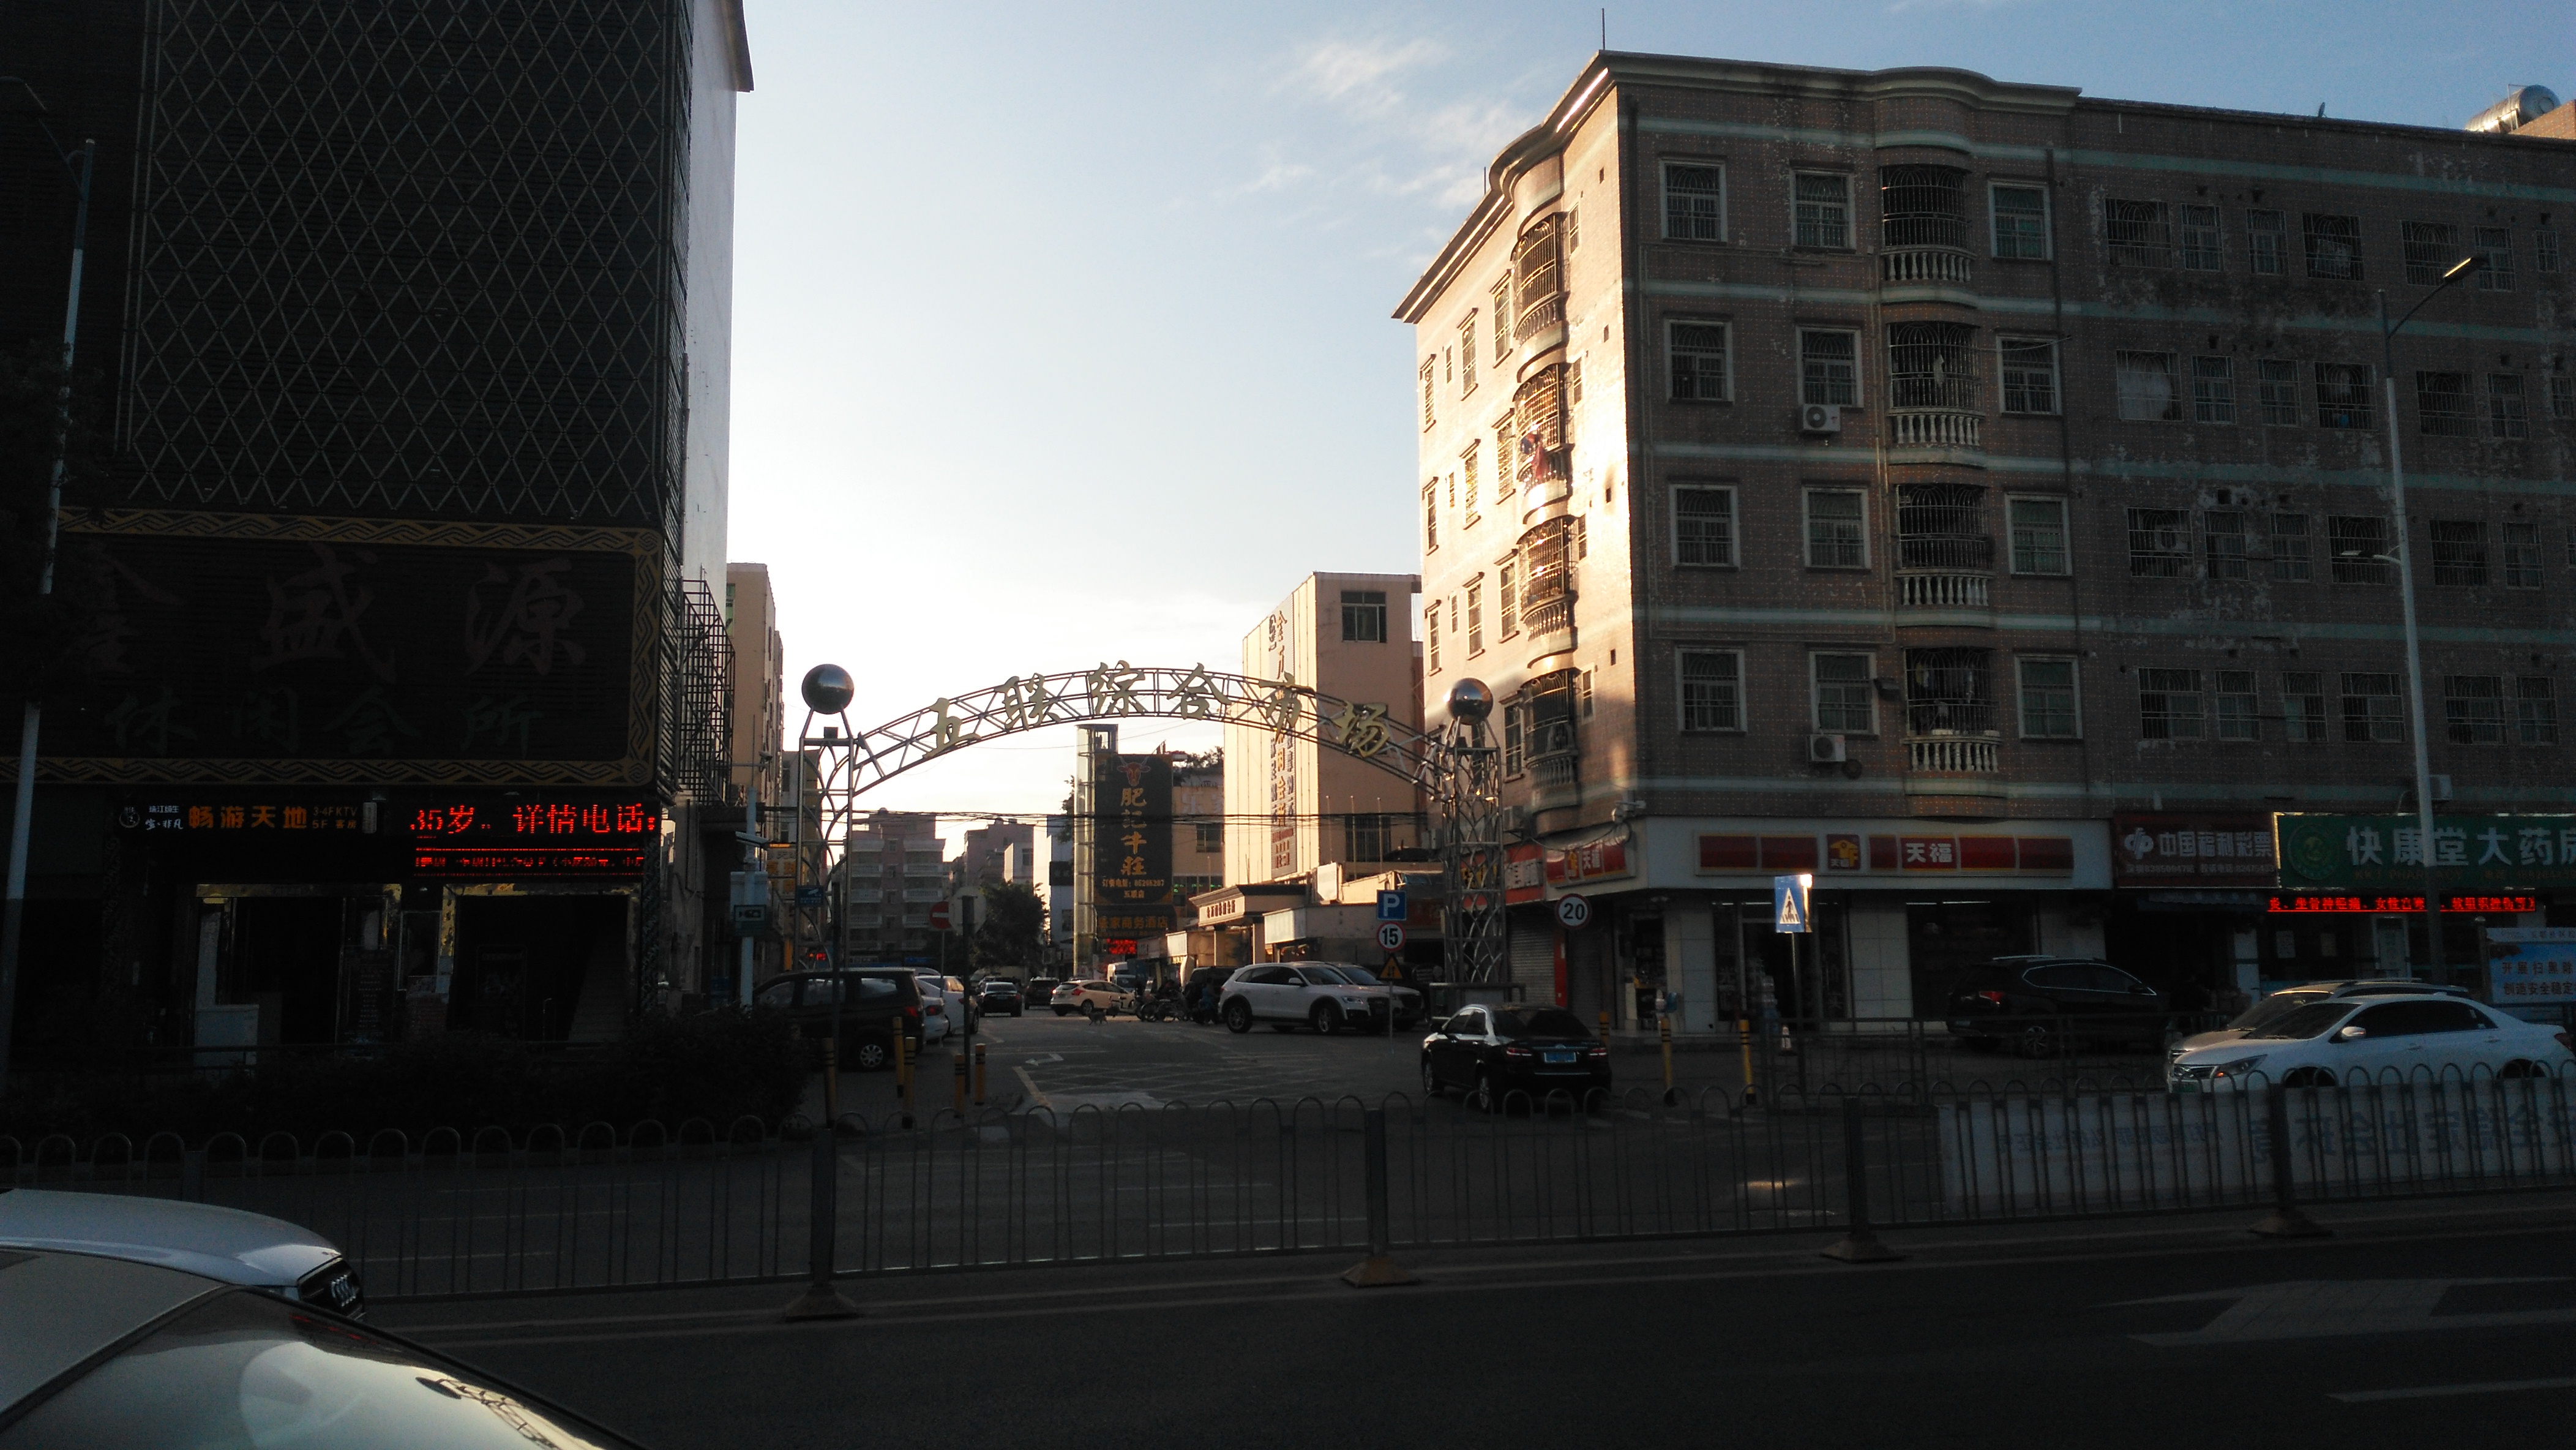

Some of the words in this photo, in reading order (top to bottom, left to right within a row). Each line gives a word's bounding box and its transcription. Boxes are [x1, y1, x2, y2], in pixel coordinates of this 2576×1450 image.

[922, 660, 1389, 758] 五联综合市场
[105, 685, 545, 759] 休闲会所
[188, 805, 307, 830] 畅游天地
[336, 806, 358, 816] KTV
[312, 819, 328, 829] 5F
[1905, 842, 1953, 863] 天福
[2157, 830, 2273, 857] 中国福利彩票
[1383, 893, 1401, 917] P
[1563, 903, 1585, 920] 20
[1382, 928, 1398, 945] 15
[2504, 982, 2576, 996] 创造安全稳定
